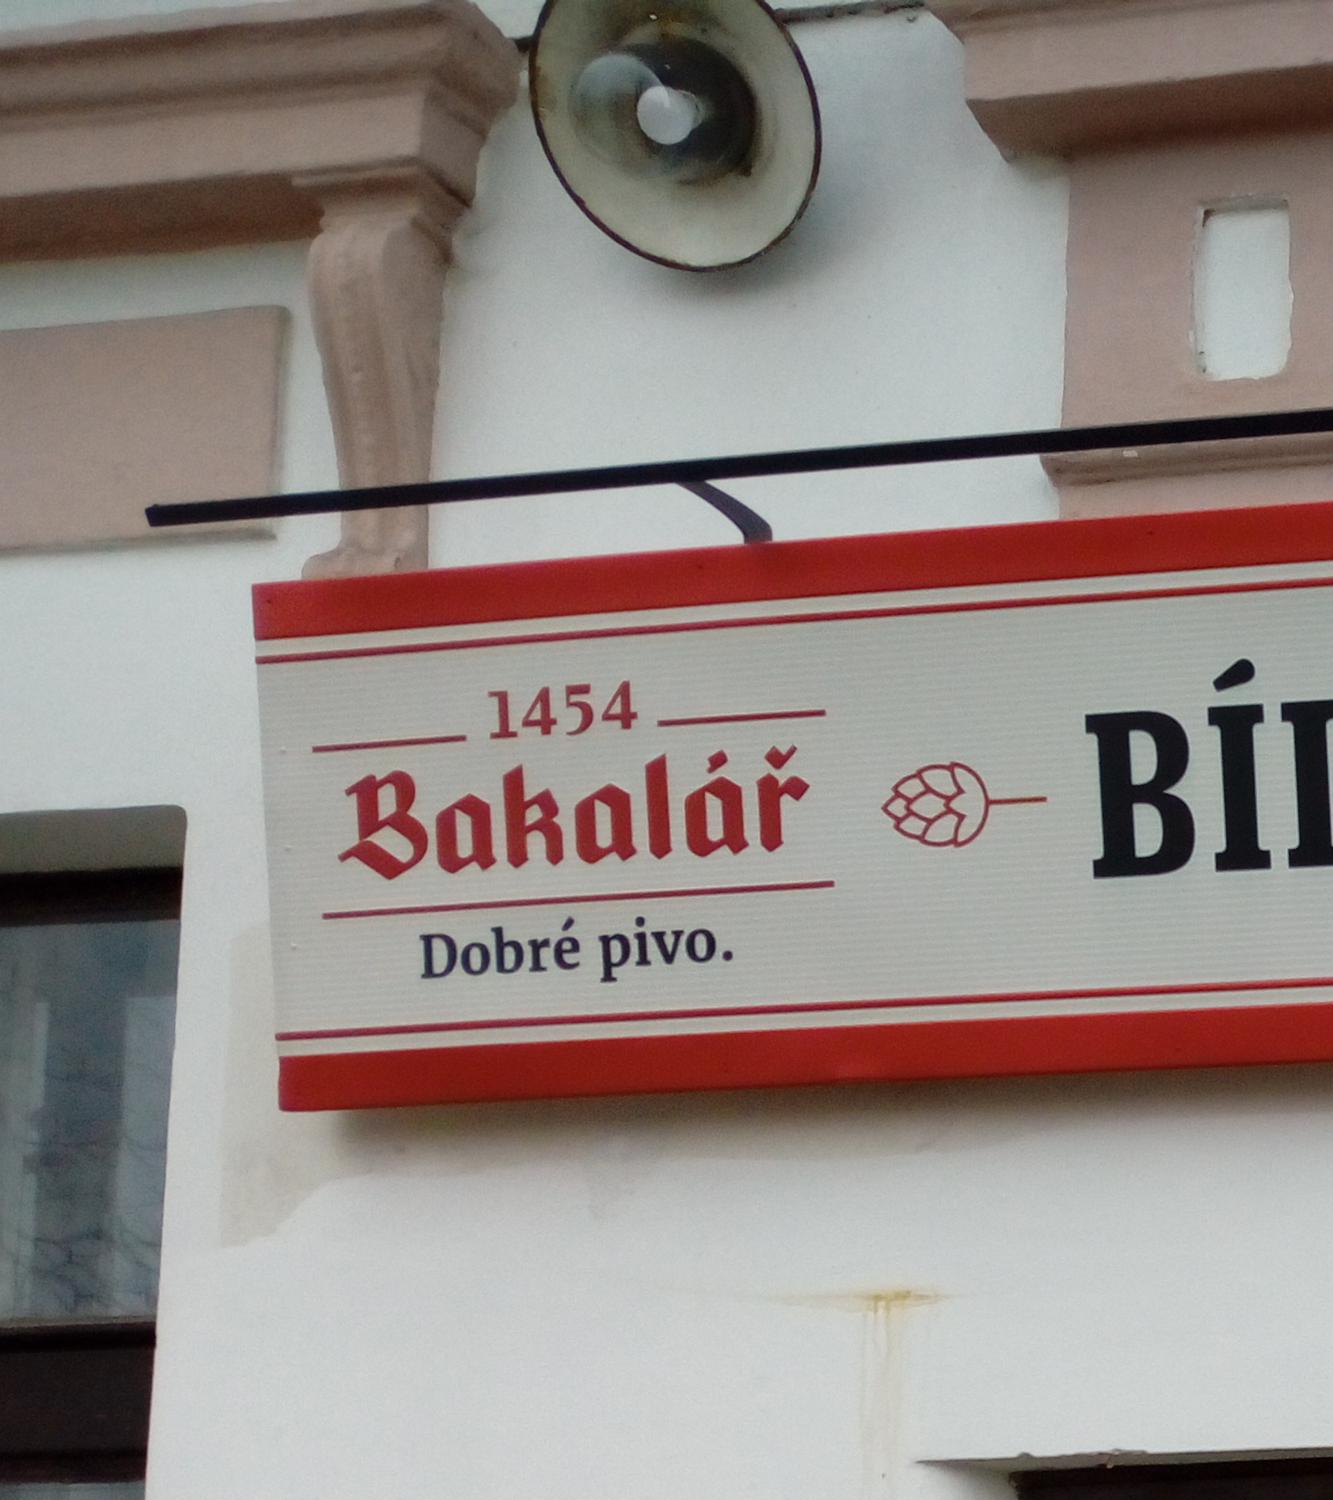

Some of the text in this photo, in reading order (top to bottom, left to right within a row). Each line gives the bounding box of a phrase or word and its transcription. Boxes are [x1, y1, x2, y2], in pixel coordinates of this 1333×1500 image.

[487, 680, 638, 740] 1454
[337, 743, 811, 881] Bakalář
[420, 915, 735, 982] Dobré pivo.
